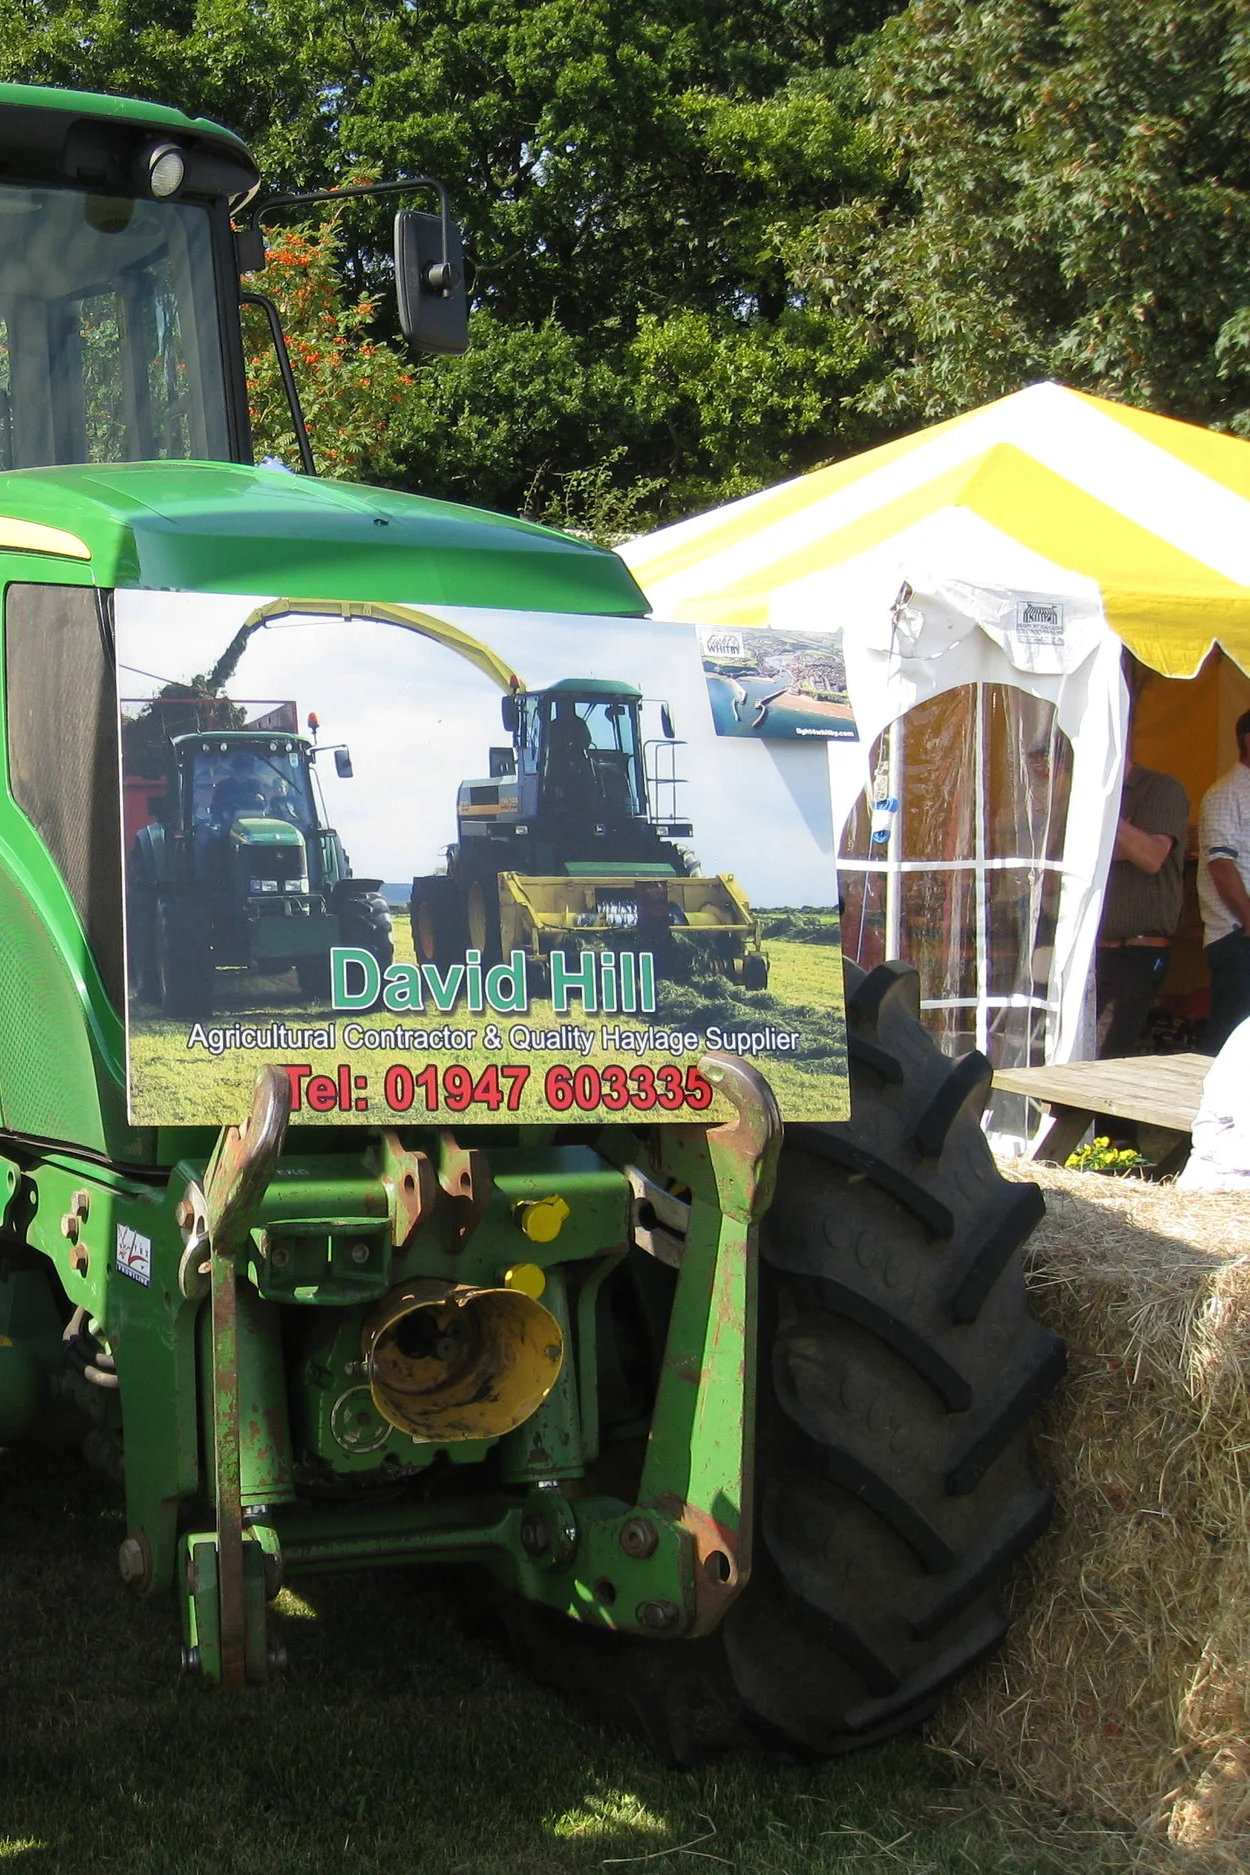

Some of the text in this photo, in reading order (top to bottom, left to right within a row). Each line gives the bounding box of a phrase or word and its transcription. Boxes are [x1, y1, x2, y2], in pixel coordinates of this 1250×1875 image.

[707, 645, 740, 654] WHITBY
[330, 947, 656, 1013] David Hill
[187, 1022, 800, 1056] Agricultural Contractor & Quality Haylage Supplier
[276, 1063, 713, 1111] Tel: 01947 603335
